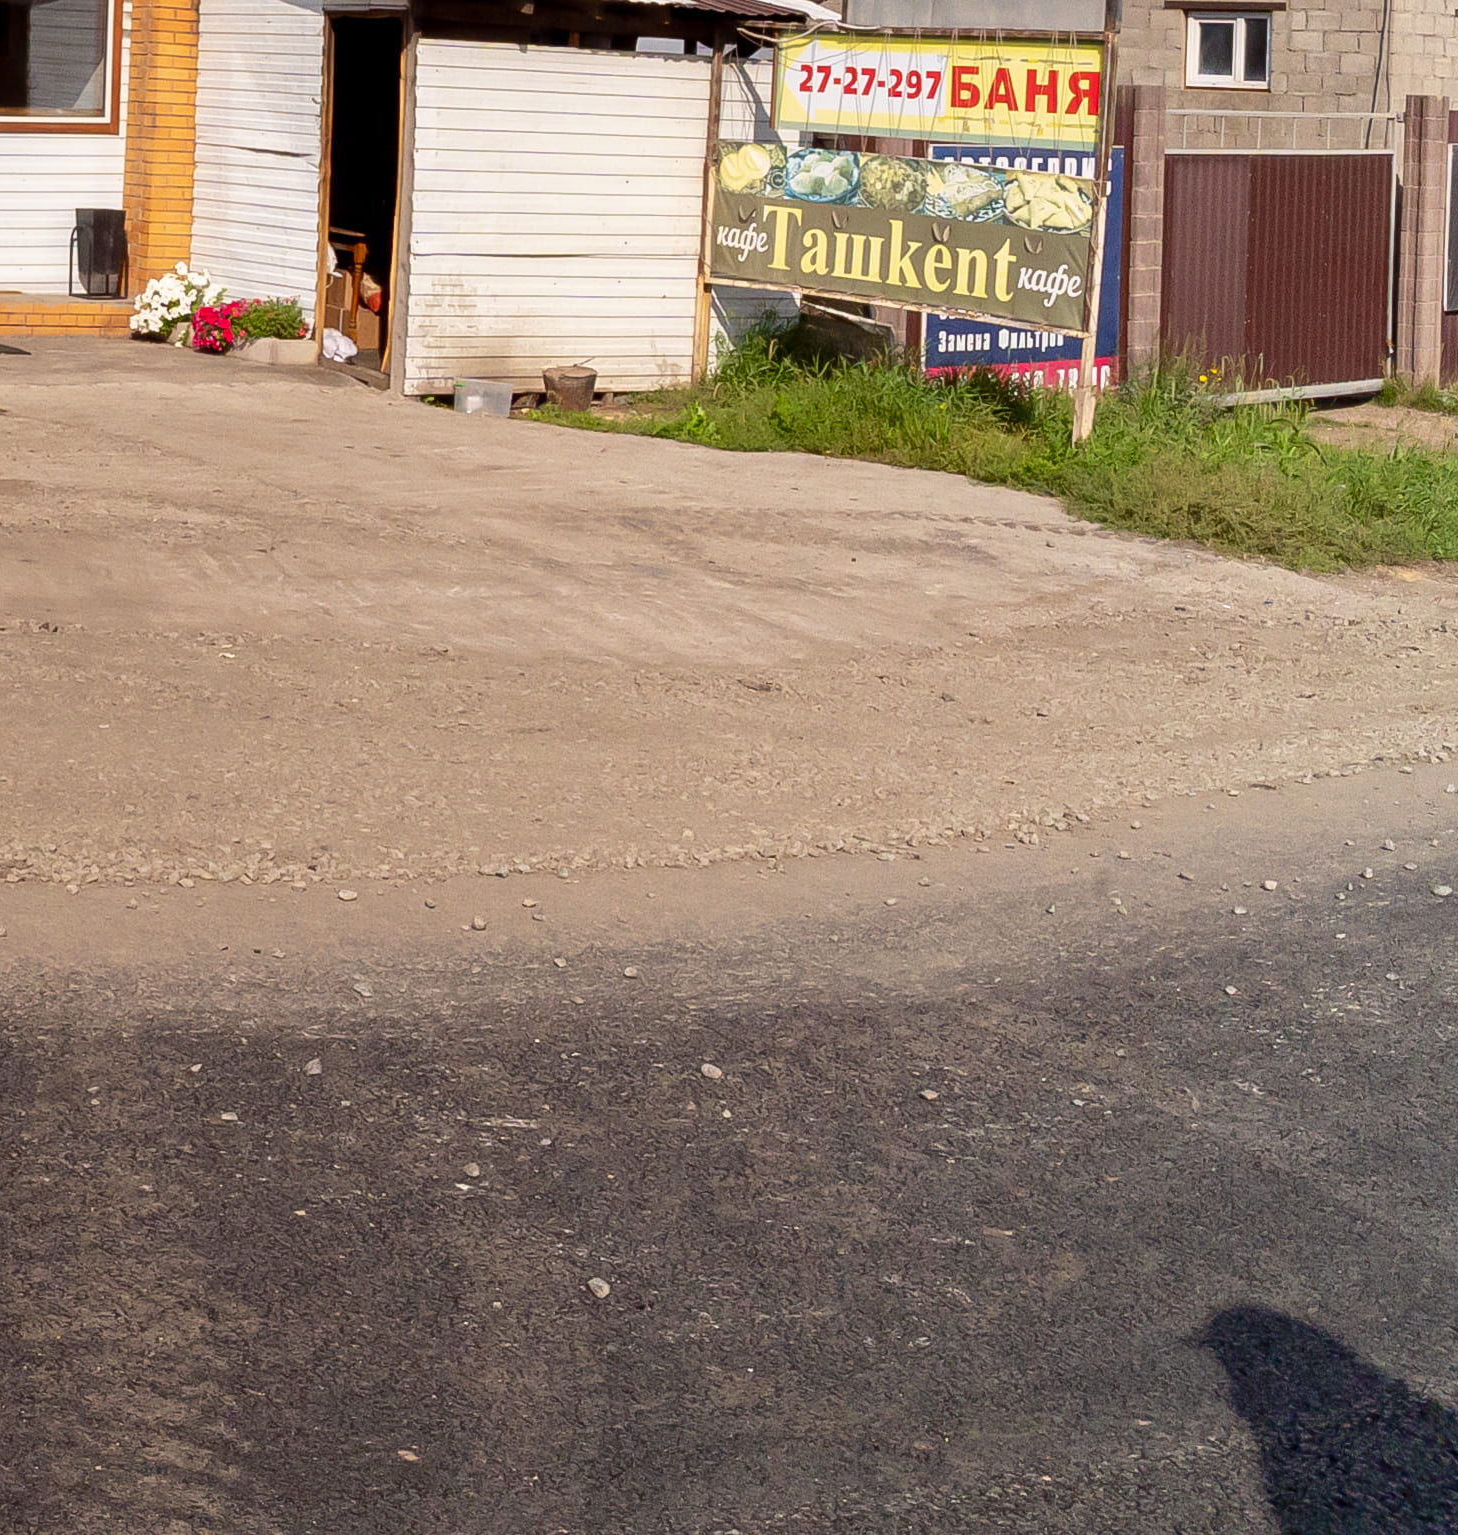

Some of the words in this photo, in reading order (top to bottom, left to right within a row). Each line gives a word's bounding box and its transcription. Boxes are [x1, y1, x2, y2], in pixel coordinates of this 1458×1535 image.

[800, 65, 942, 100] 27-27-297
[950, 66, 1100, 116] БАНЯ
[716, 222, 768, 261] кафе
[1017, 264, 1082, 307] кафе
[938, 330, 991, 353] Замена
[998, 328, 1065, 352] Фильтров
